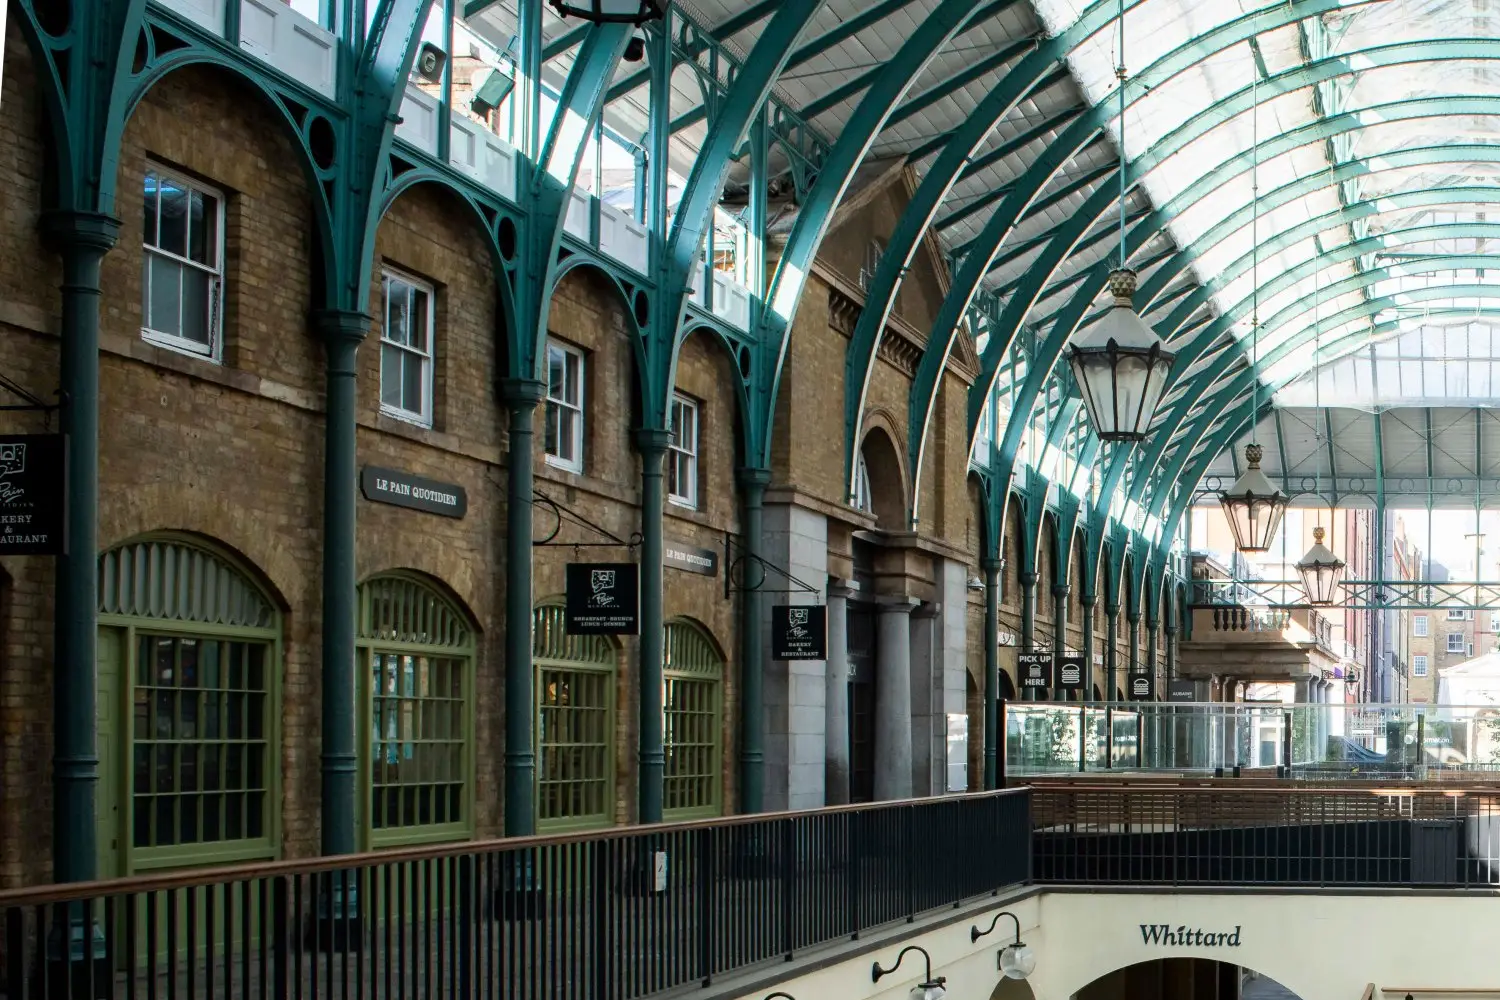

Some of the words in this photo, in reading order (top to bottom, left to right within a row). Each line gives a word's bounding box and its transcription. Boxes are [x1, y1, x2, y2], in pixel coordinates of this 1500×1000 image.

[376, 478, 388, 491] LE
[390, 481, 410, 496] PAIN
[412, 486, 457, 506] QUOTIDIEN
[0, 514, 33, 524] KERY
[0, 534, 48, 544] AURANT
[666, 548, 674, 559] LE
[1019, 655, 1037, 663] PICK
[1040, 655, 1052, 663] UP
[1025, 678, 1045, 686] HERE
[1140, 924, 1241, 946] Whittard
